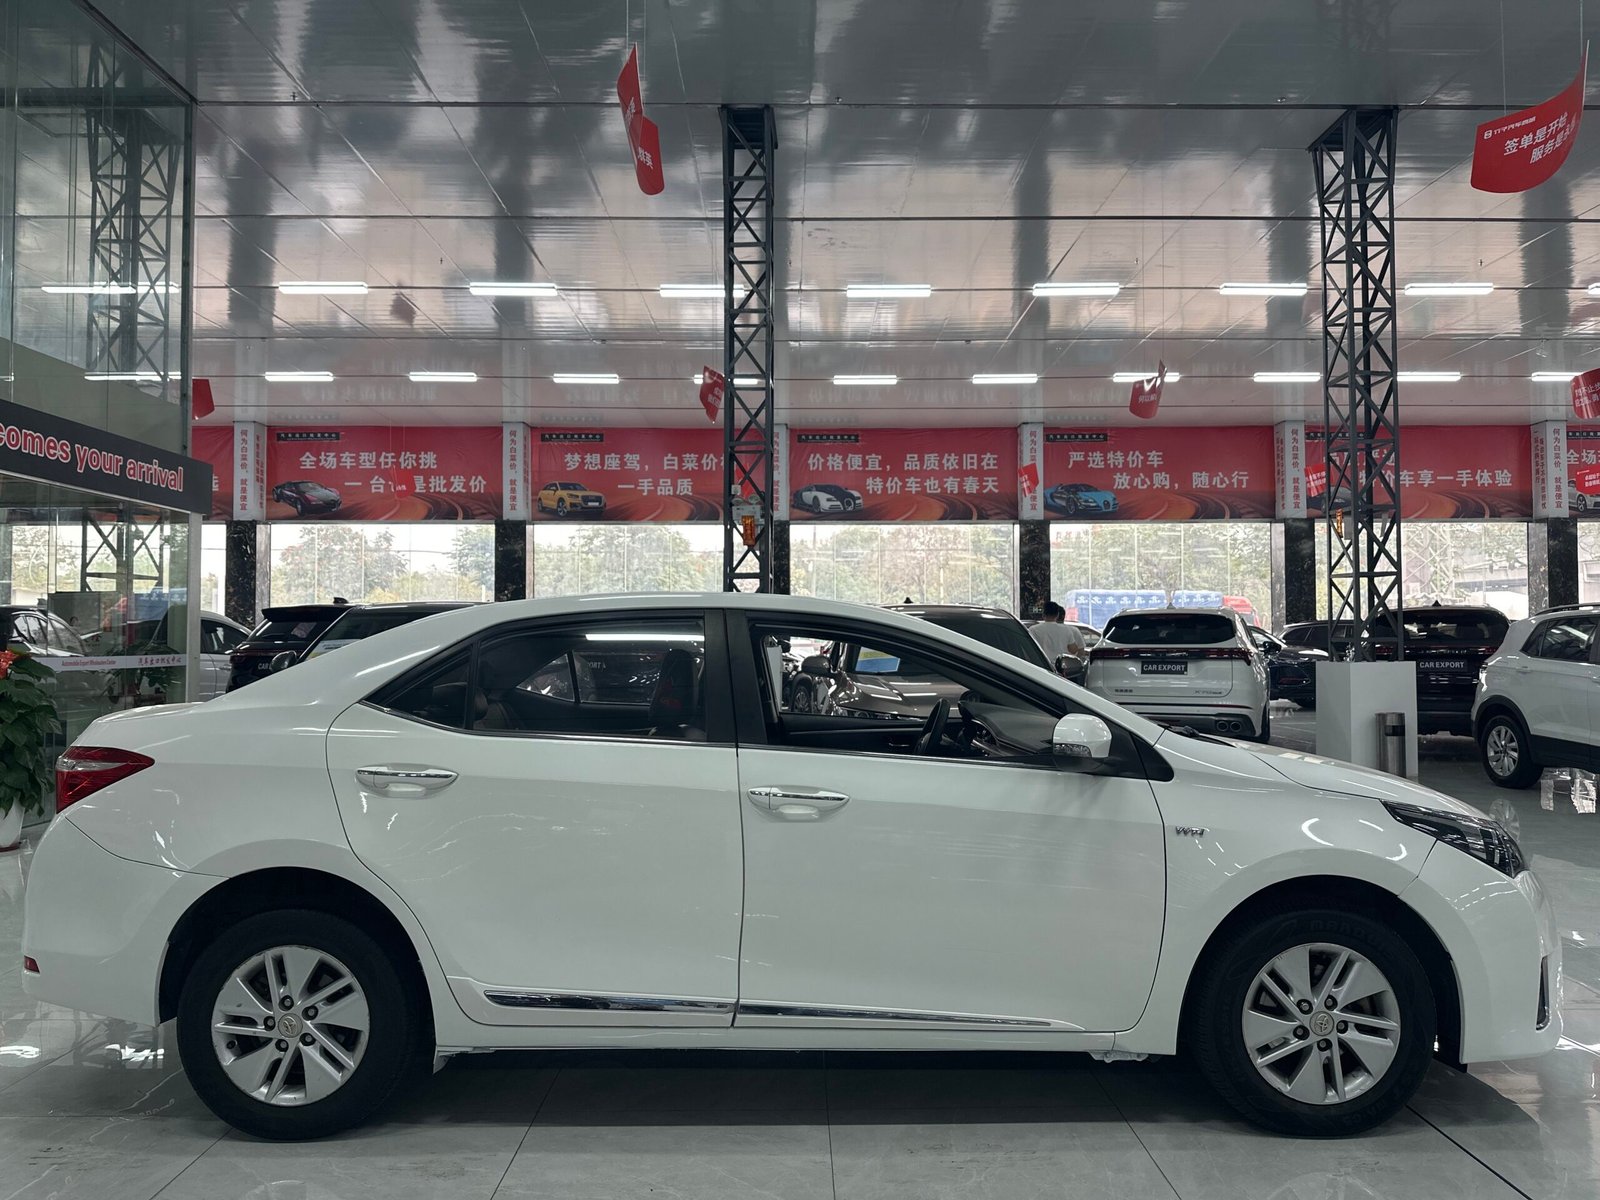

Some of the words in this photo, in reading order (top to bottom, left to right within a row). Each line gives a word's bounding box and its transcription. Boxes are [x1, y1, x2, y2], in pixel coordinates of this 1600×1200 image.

[298, 451, 438, 470] 全场车型任你挑
[564, 453, 725, 472] 梦想座驾，白菜价
[807, 452, 999, 472] 价格便宜，品质依旧在
[1067, 450, 1165, 469] 严选特价车
[1567, 448, 1600, 465] 全场
[75, 443, 123, 477] your
[126, 458, 184, 492] arrival
[344, 474, 487, 494] 一台是批发价
[617, 477, 693, 496] 一手品质
[866, 476, 999, 495] 特价车也有春天
[1113, 471, 1250, 490] 放心购，随心行
[1143, 664, 1158, 672] CAR
[1158, 664, 1186, 672] EXPORT
[1419, 661, 1434, 669] CAR
[1435, 661, 1465, 669] EXPORT
